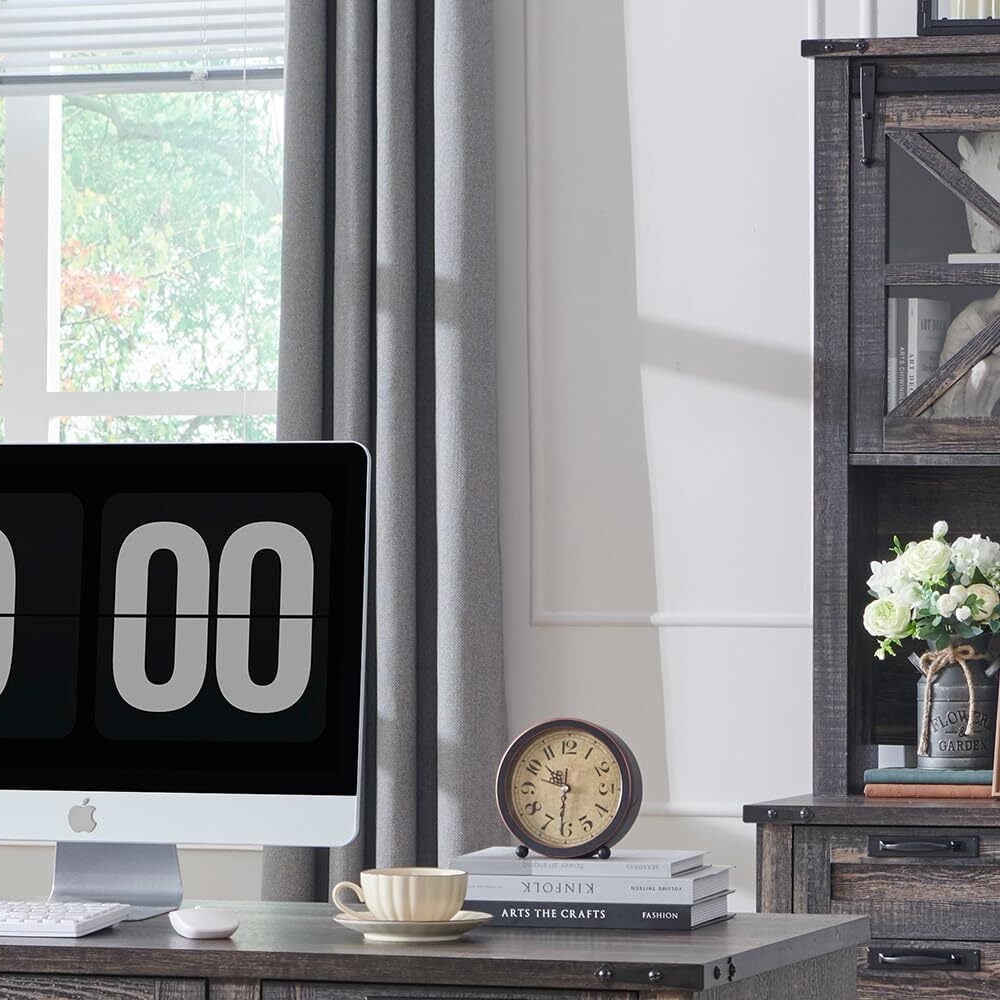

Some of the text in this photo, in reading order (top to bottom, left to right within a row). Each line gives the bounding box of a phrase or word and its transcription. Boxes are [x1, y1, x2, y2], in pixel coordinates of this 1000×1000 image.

[112, 521, 314, 713] 00
[543, 745, 555, 760] 11
[562, 740, 577, 755] 12
[584, 747, 594, 760] 1
[939, 740, 988, 752] GARDEN
[526, 759, 542, 776] 10
[594, 761, 610, 777] 2
[520, 781, 536, 795] 9
[598, 782, 615, 796] 3
[525, 801, 542, 816] 8
[594, 803, 609, 818] 4
[541, 813, 555, 831] 7
[560, 821, 573, 837] 6
[578, 815, 594, 832] 5
[521, 881, 594, 894] KINFOLK
[501, 908, 606, 919] ARTS THE CRAFTS
[642, 911, 679, 919] FASHION
